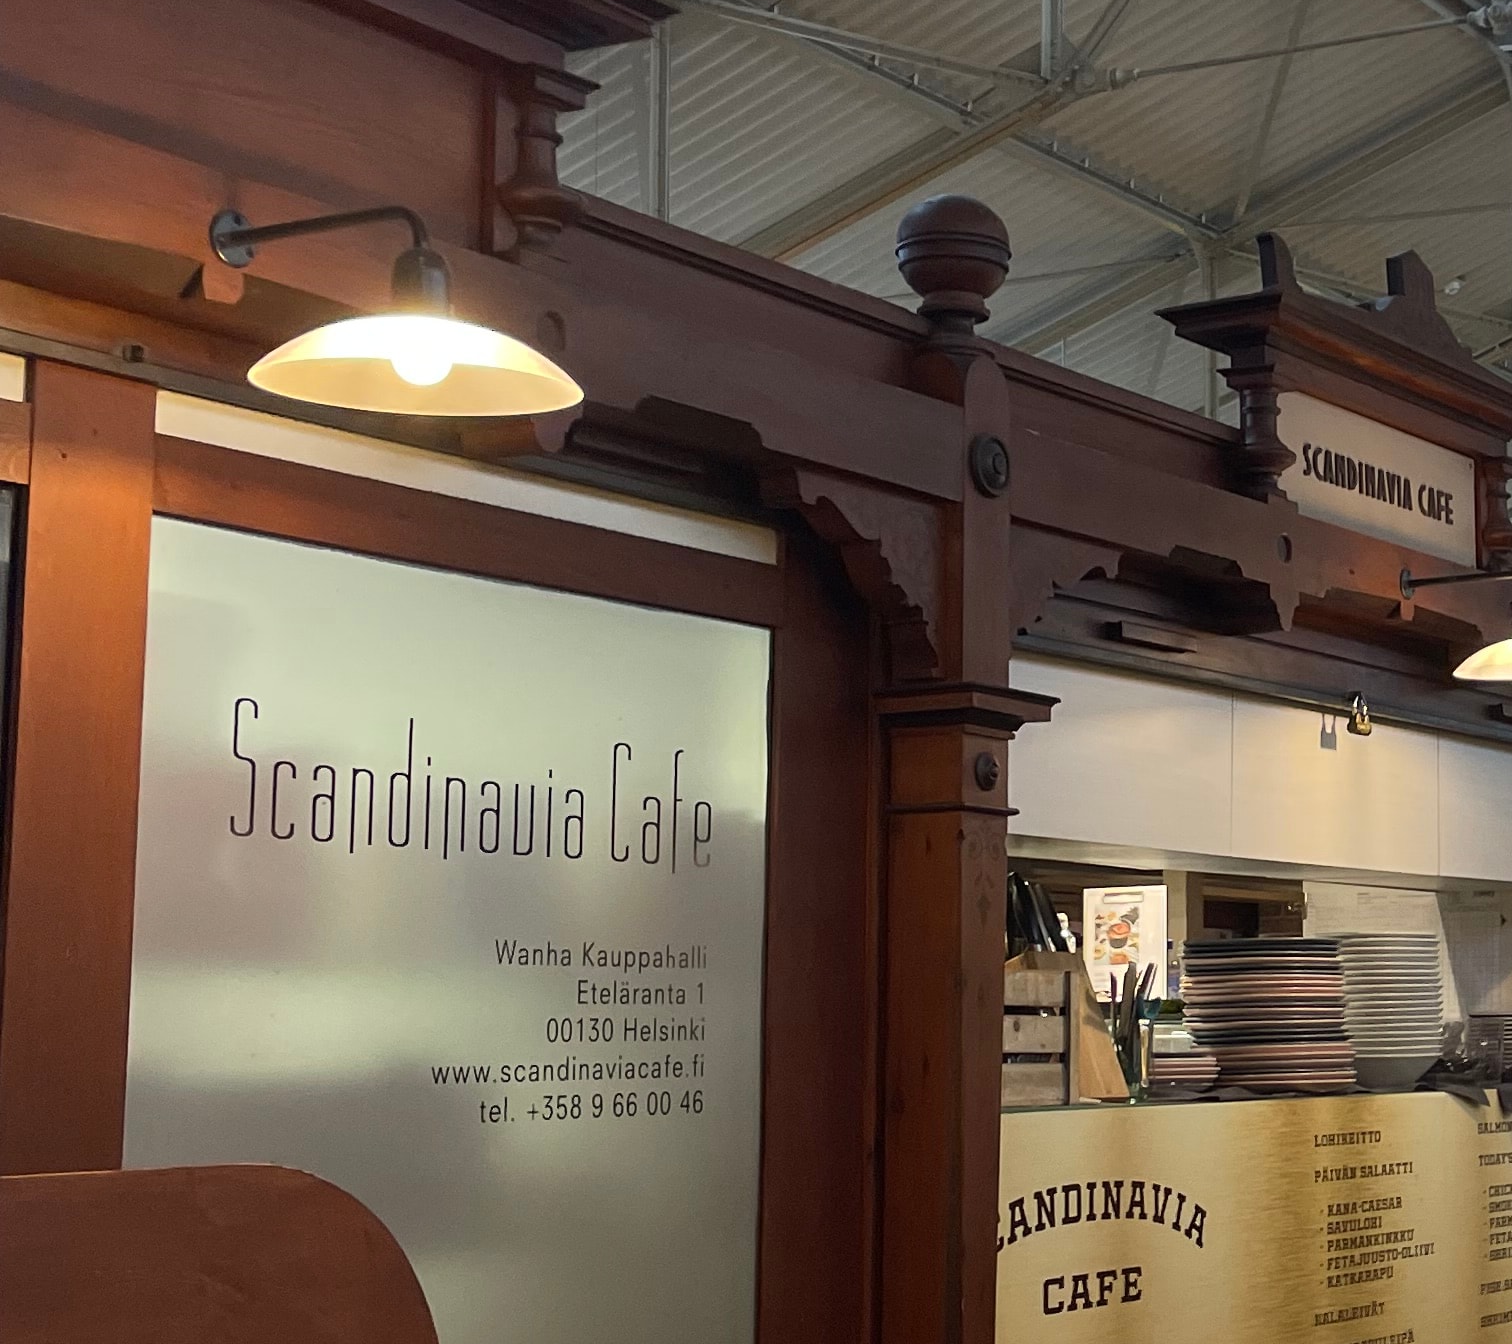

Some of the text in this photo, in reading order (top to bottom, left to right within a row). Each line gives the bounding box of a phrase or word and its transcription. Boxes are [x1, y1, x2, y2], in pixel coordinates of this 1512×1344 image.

[1302, 443, 1454, 525] SCANDINAVIA CAFE
[611, 743, 711, 874] Cafe
[495, 939, 707, 974] Wanha Kauppahalli
[577, 979, 704, 1005] Eteläranta 1
[546, 1017, 706, 1043] 00130 Helsinki
[431, 1054, 705, 1084] www.scandinaviacafe.fi
[480, 1090, 704, 1123] tel. +358 9 66 00 46
[1314, 1130, 1381, 1147] LOHIKEITTO
[1314, 1161, 1413, 1183] PÄIVÄN SALAATTI
[1327, 1196, 1403, 1217] KANA-CAESAR
[1327, 1216, 1382, 1235] SAVULOHI
[1327, 1229, 1415, 1252] PARMANKINKKU
[1327, 1265, 1394, 1288] KATKARAPU
[1043, 1266, 1143, 1316] CAFE
